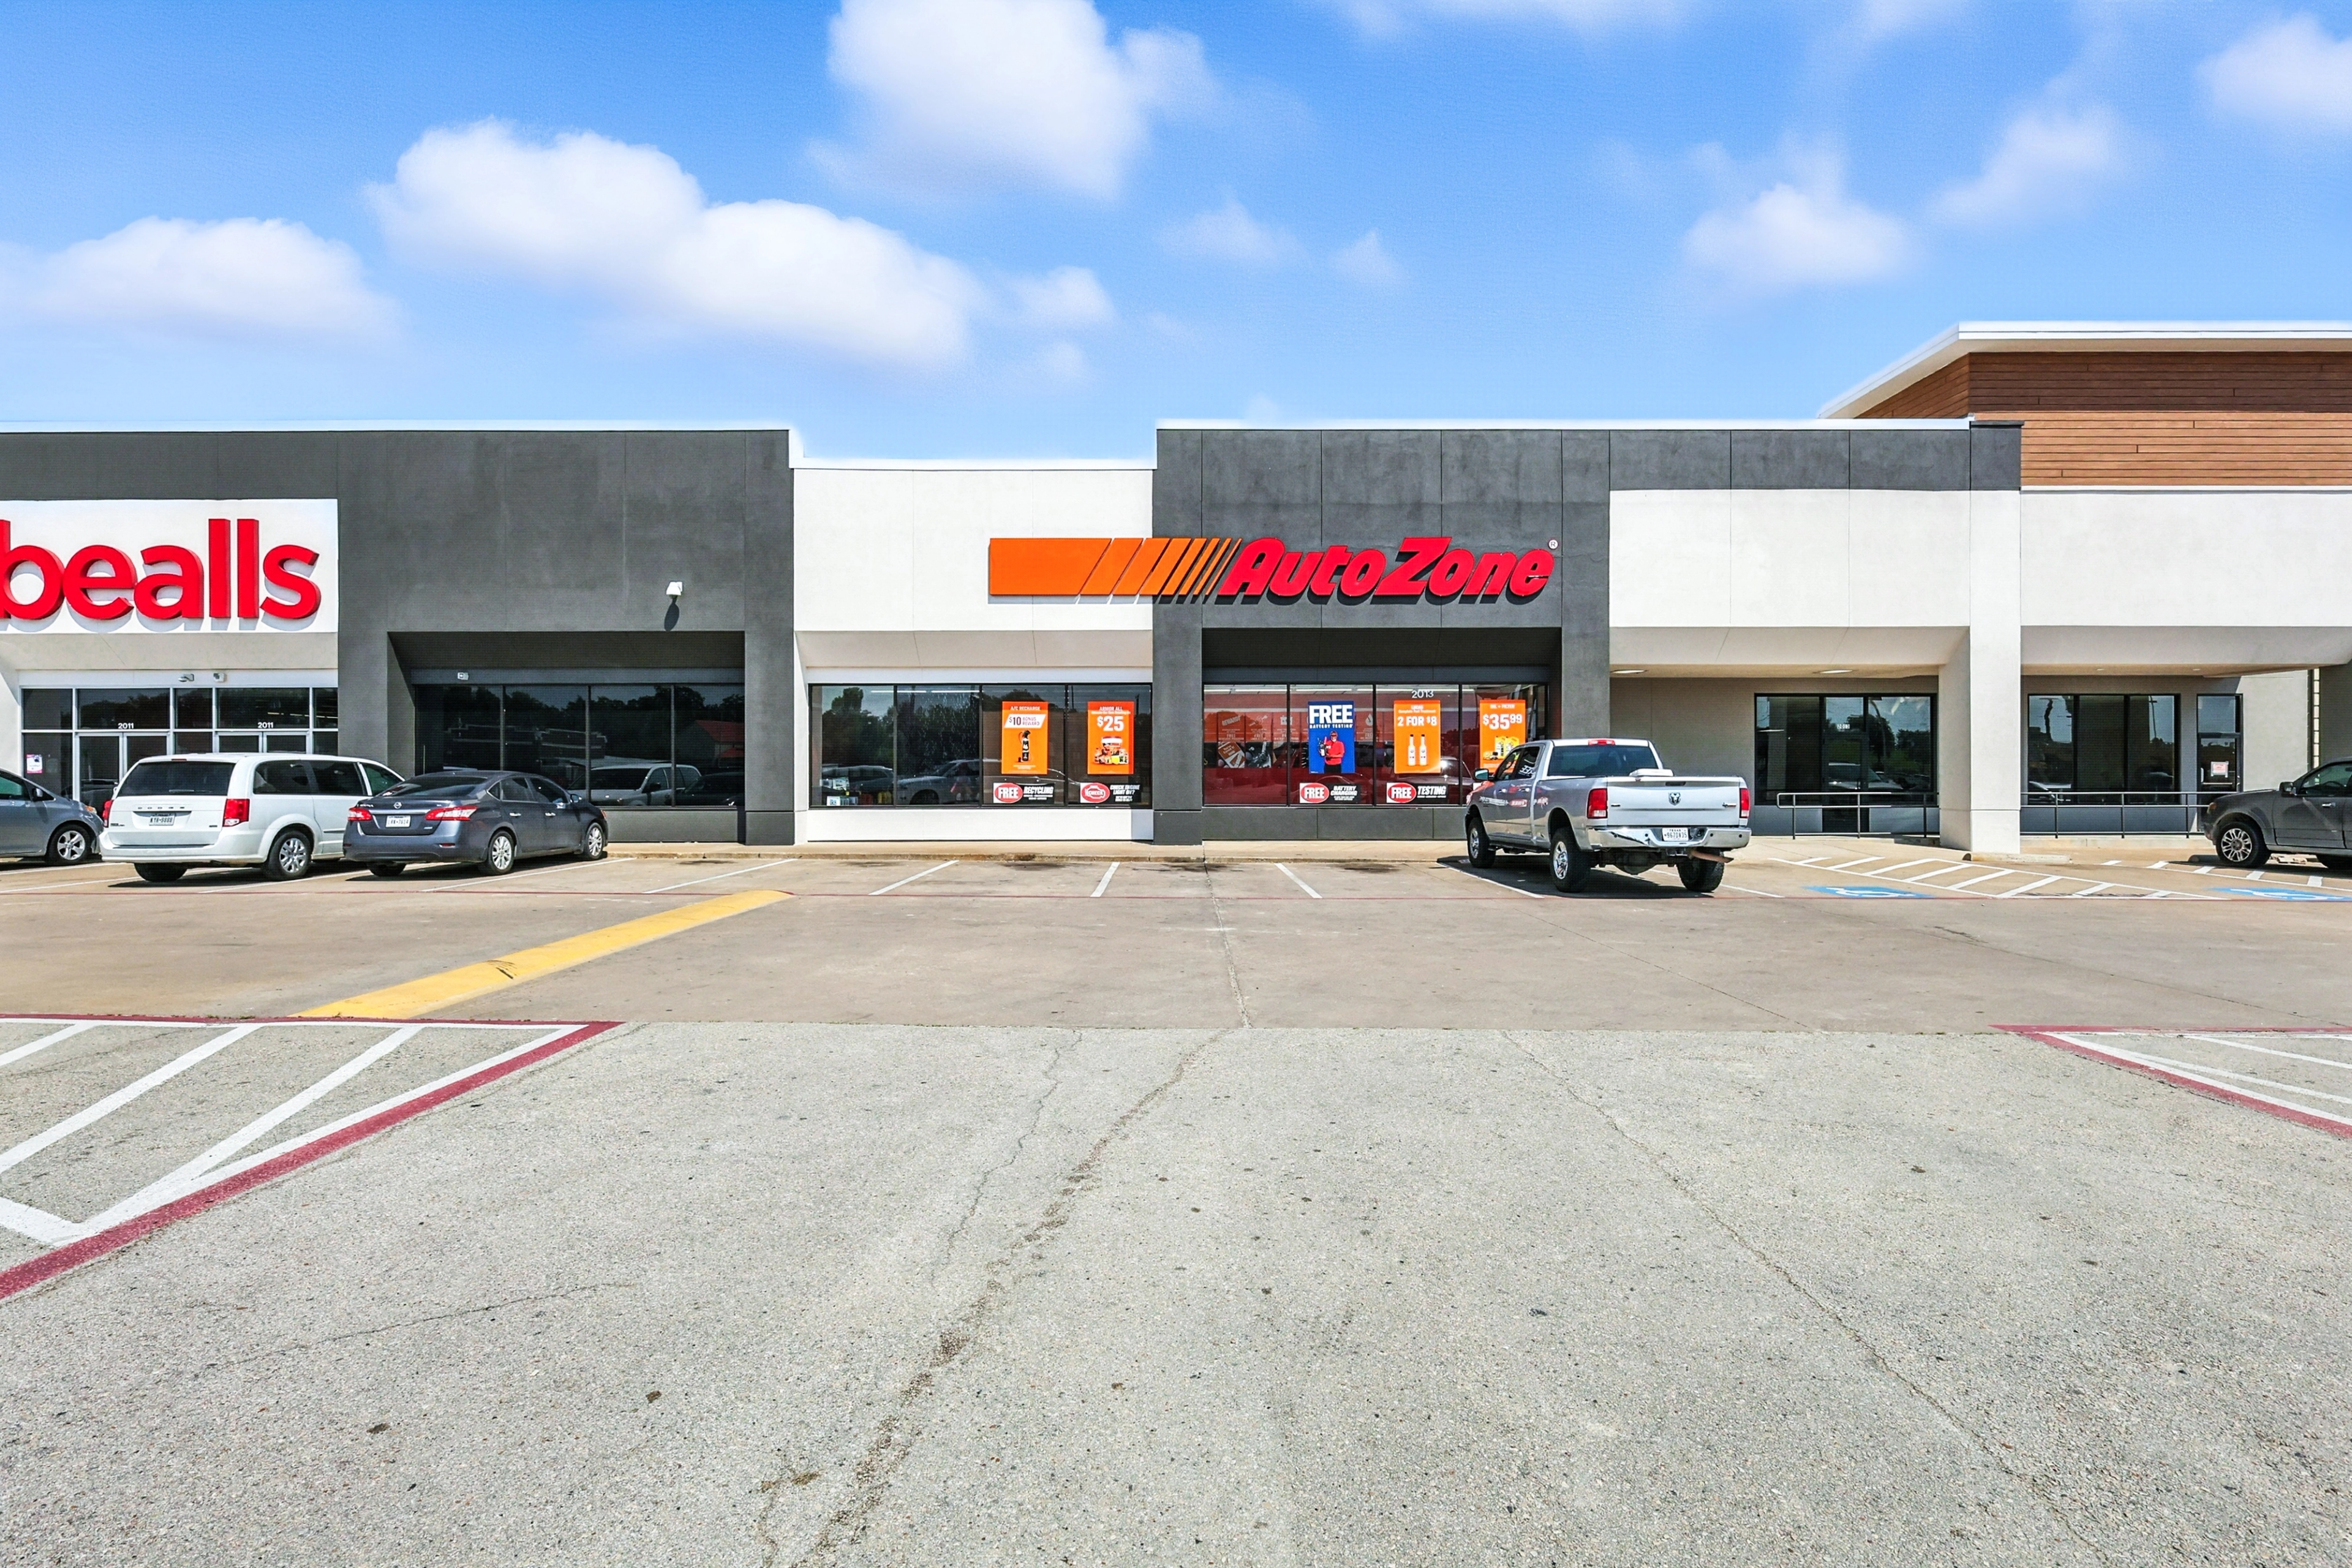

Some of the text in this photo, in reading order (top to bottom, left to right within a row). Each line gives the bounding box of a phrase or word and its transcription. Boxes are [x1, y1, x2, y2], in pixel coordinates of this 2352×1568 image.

[0, 519, 321, 620] bealls
[1218, 537, 1554, 597] AutoZone
[1411, 690, 1434, 698] 2013
[1309, 704, 1353, 724] FREE
[1009, 717, 1021, 725] $10
[1097, 715, 1124, 731] $25
[1398, 715, 1437, 726] 2 FOR $8
[998, 787, 1019, 799] FREE
[1304, 787, 1325, 799] FREE
[1391, 787, 1412, 799] FREE
[1417, 786, 1446, 795] TESTING
